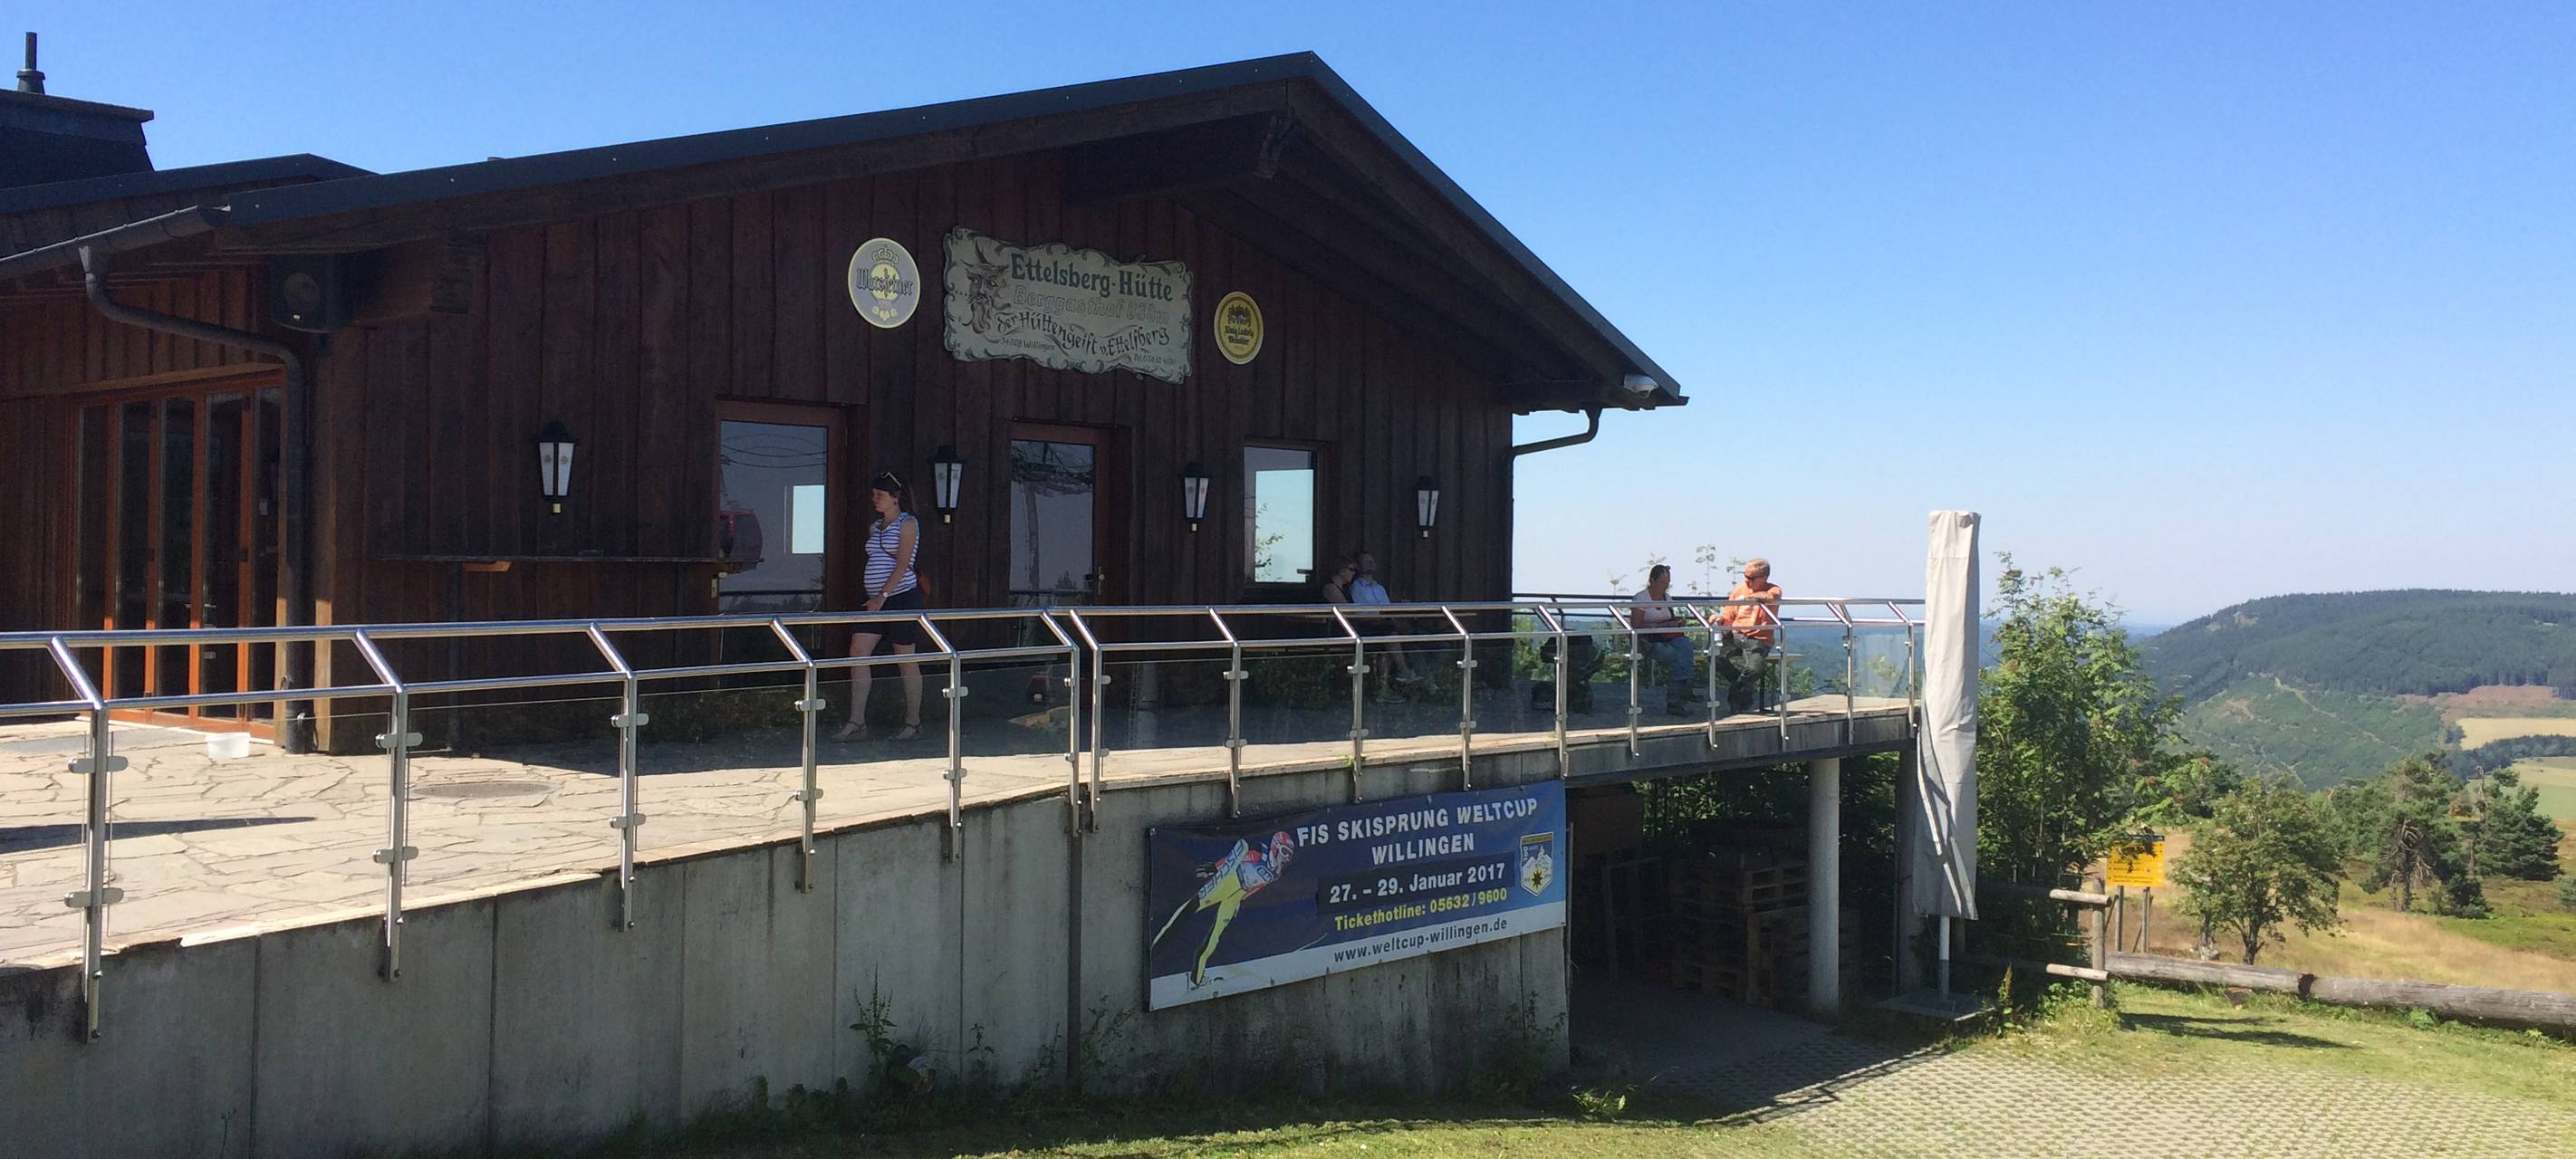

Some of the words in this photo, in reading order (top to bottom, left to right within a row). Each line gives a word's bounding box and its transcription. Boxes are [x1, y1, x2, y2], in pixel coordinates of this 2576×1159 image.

[1296, 825, 1329, 847] FIS
[1337, 808, 1448, 841] SKISPRUNG
[1456, 798, 1537, 825] WELTCUP
[1371, 832, 1475, 865] WILLINGEN
[1329, 884, 1357, 904] 27.
[1378, 877, 1403, 896] 29.
[1409, 871, 1463, 892] Januar
[1467, 862, 1505, 884] 2017
[1334, 905, 1426, 931] Tickethotline:
[1334, 917, 1507, 963] www.weltcup-willingen.de
